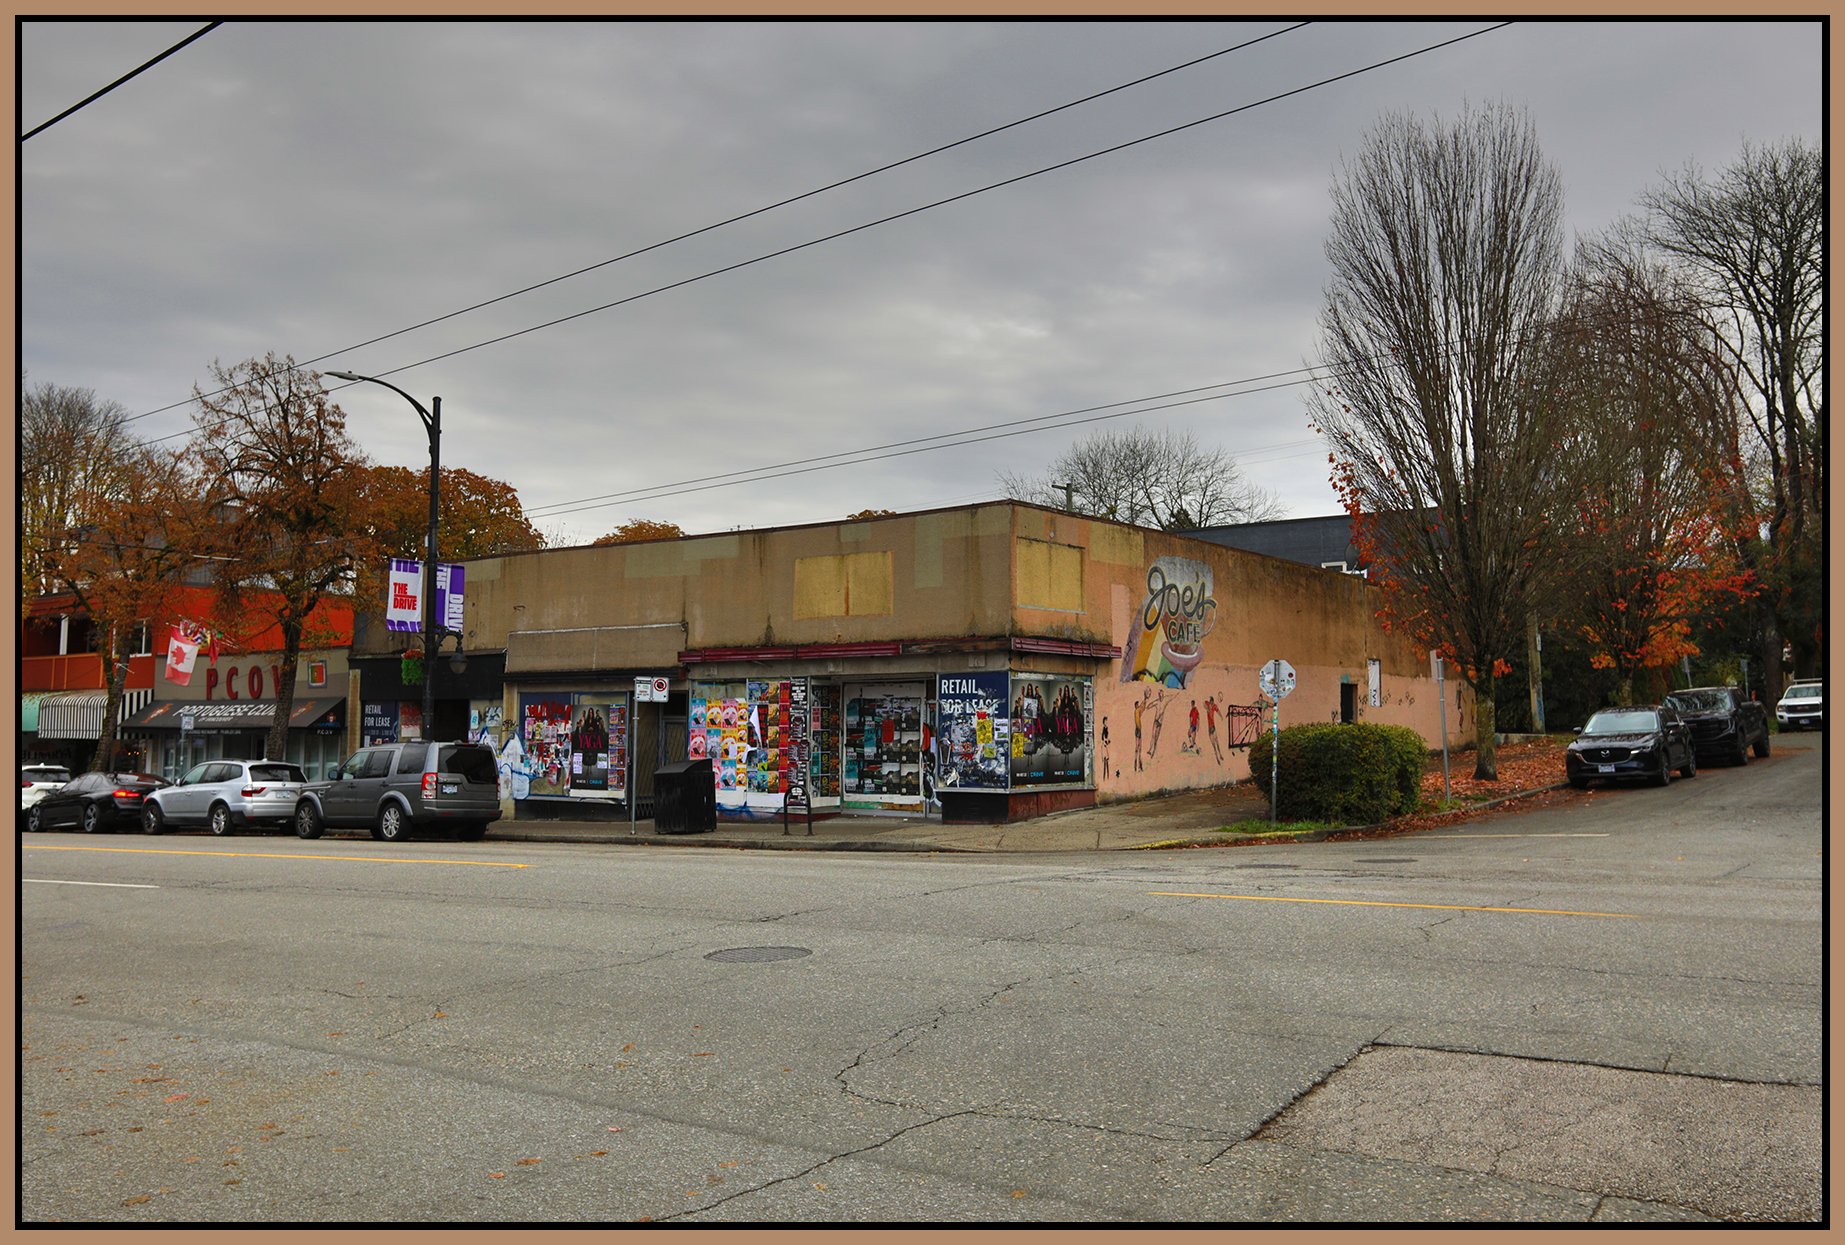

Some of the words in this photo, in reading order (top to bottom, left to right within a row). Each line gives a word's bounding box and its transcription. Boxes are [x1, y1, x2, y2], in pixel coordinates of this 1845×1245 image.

[436, 564, 447, 589] THE
[393, 582, 408, 594] THE
[393, 598, 417, 611] DRIVE
[1144, 566, 1217, 630] Joe's
[1168, 621, 1200, 643] CAFE
[941, 679, 978, 694] RETAIL
[365, 704, 382, 715] RETAIL
[364, 716, 375, 727] FOR
[376, 716, 391, 727] LEASE
